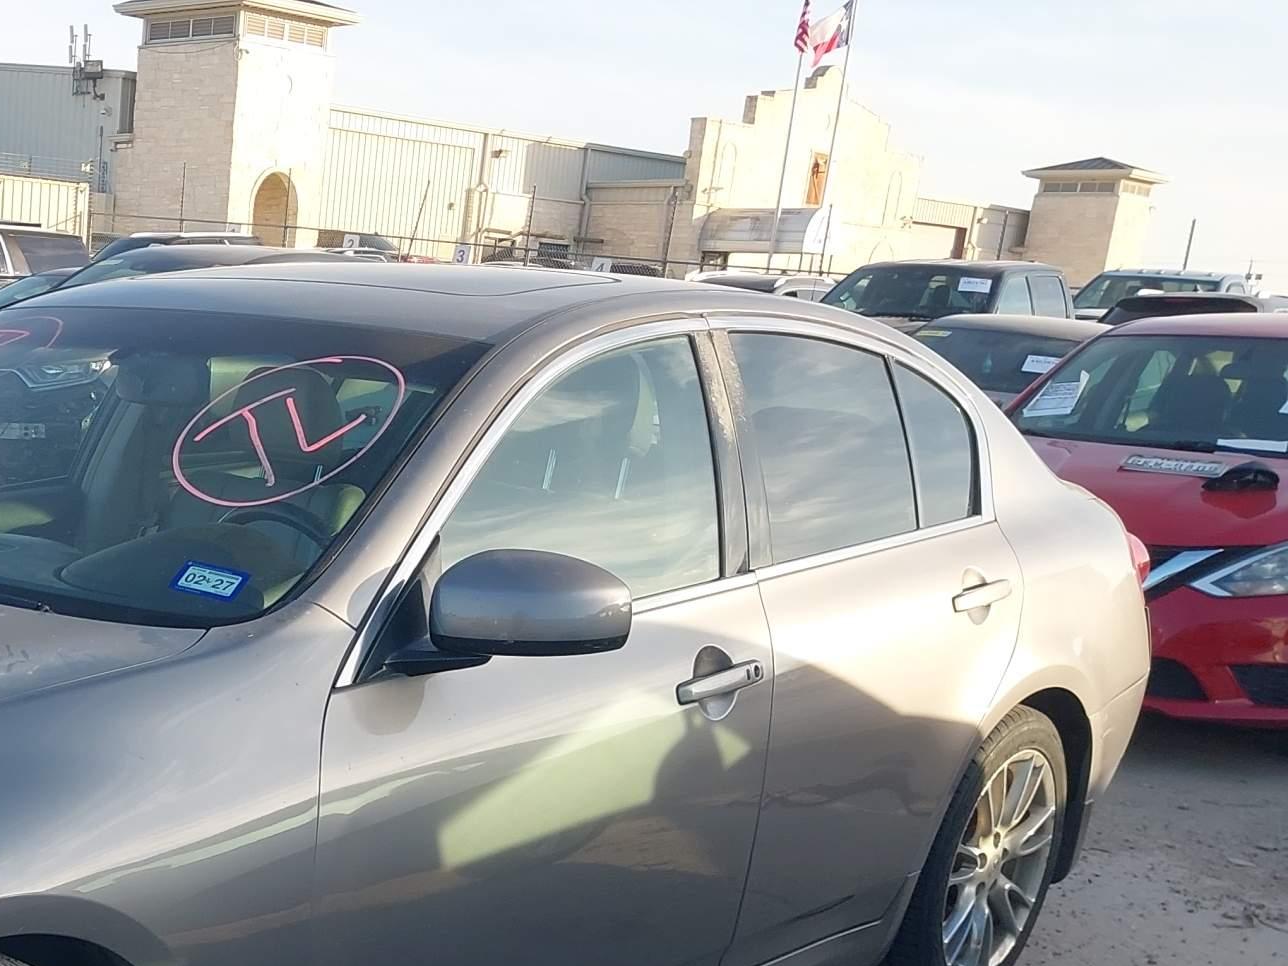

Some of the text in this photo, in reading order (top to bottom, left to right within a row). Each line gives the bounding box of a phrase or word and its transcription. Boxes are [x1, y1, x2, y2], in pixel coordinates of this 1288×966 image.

[456, 249, 466, 263] 3
[193, 387, 368, 487] TL
[211, 578, 235, 591] 27
